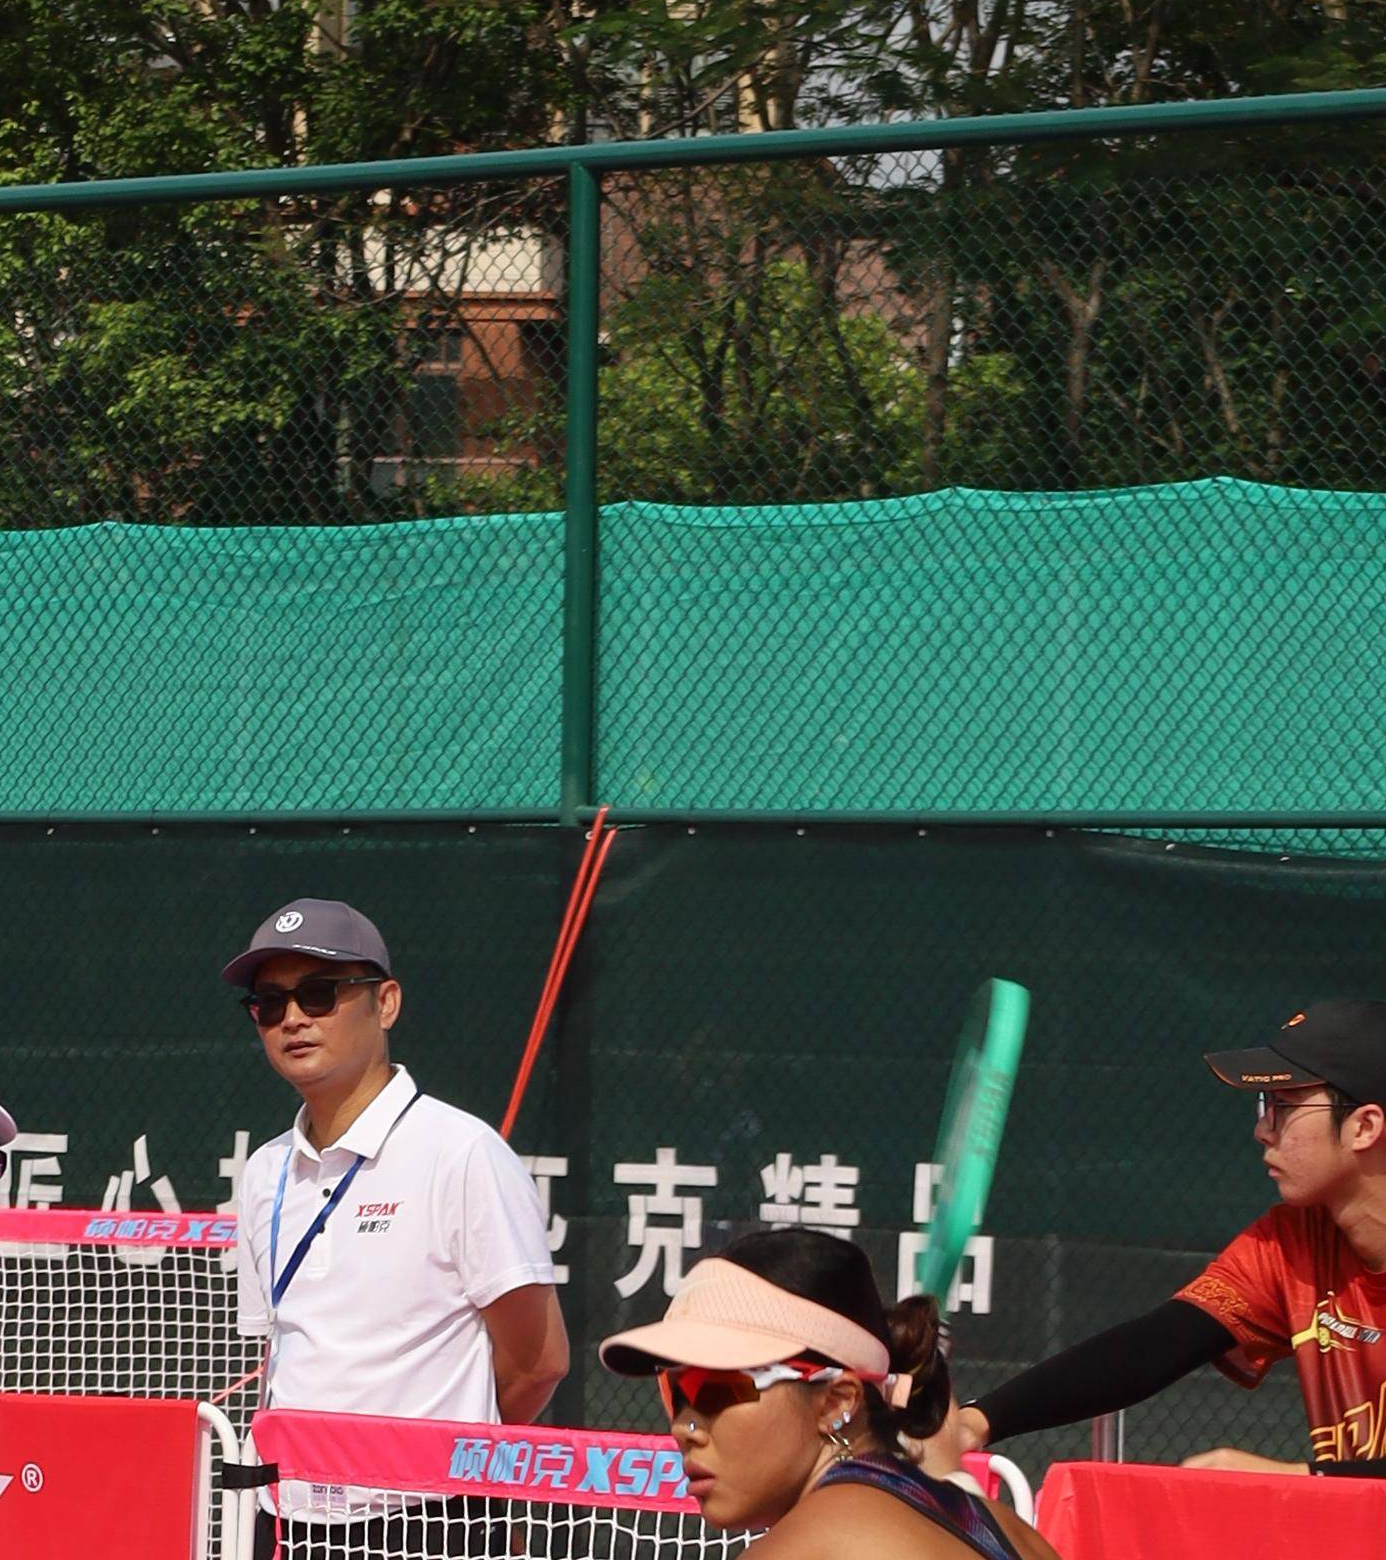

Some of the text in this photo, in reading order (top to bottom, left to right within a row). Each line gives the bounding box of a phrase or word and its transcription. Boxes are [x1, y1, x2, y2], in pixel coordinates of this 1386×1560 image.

[1272, 1073, 1292, 1082] PRO
[448, 1437, 575, 1490] 硕帕克
